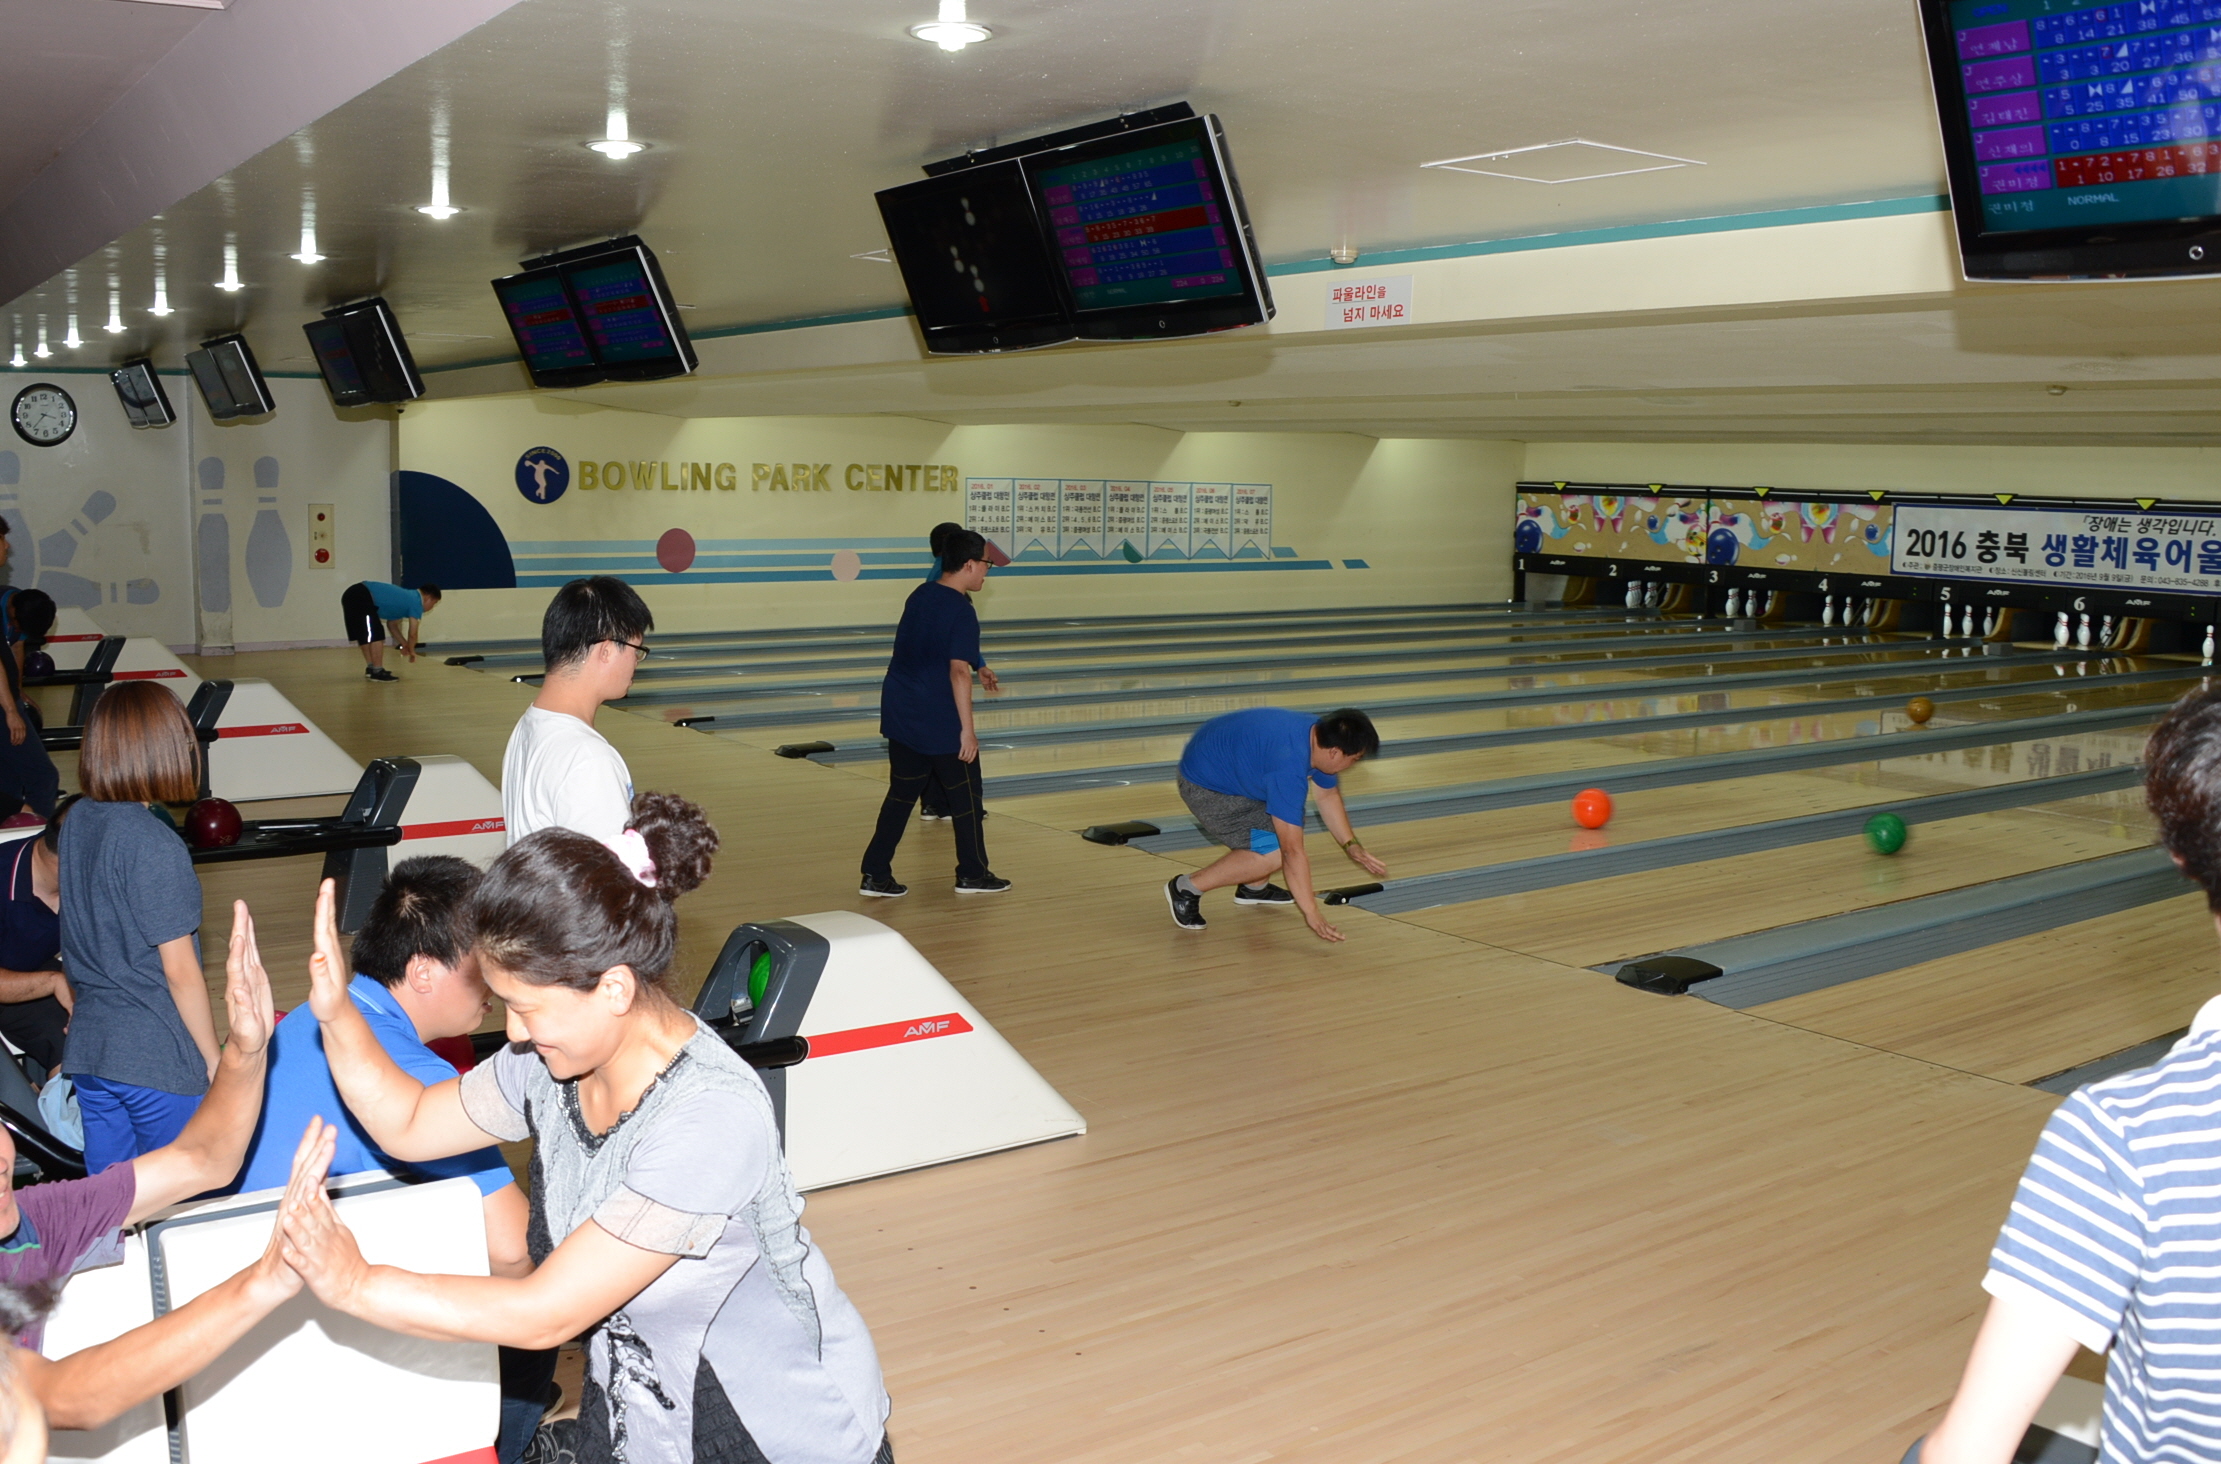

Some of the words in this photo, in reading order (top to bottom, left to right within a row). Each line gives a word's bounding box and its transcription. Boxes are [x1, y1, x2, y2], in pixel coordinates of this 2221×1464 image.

[2078, 28, 2095, 41] 14
[2105, 23, 2125, 36] 21
[2137, 18, 2157, 31] 38
[2170, 13, 2190, 25] 45
[2111, 60, 2130, 73] 20
[2142, 55, 2161, 69] 27
[2174, 51, 2194, 64] 36
[2086, 101, 2104, 113] 25
[2116, 96, 2135, 110] 35
[2147, 92, 2166, 104] 41
[2178, 88, 2198, 101] 50
[2123, 132, 2140, 144] 15
[2152, 129, 2170, 141] 23
[2183, 125, 2203, 137] 30
[2098, 171, 2114, 182] 10
[2127, 168, 2144, 180] 17
[2156, 165, 2175, 177] 26
[2067, 192, 2120, 206] NORMAL
[1332, 284, 1387, 302] 파울라인을
[1343, 306, 1365, 323] 넘지
[1370, 304, 1404, 321] 마세요
[578, 460, 737, 491] BOWLING
[751, 462, 833, 491] PARK
[844, 463, 959, 492] CENTER
[2136, 517, 2216, 537] 생각입니다.
[1906, 528, 1967, 559] 2016
[1975, 530, 2029, 564] 충북
[1518, 558, 1525, 570] 1
[1609, 564, 1618, 577] 2
[1709, 570, 1719, 583] 3
[1817, 578, 1828, 592] 4
[1940, 586, 1951, 601] 5
[2073, 596, 2086, 611] 6
[270, 725, 297, 733] AMF
[471, 821, 505, 831] AMF
[903, 1020, 950, 1038] AMF
